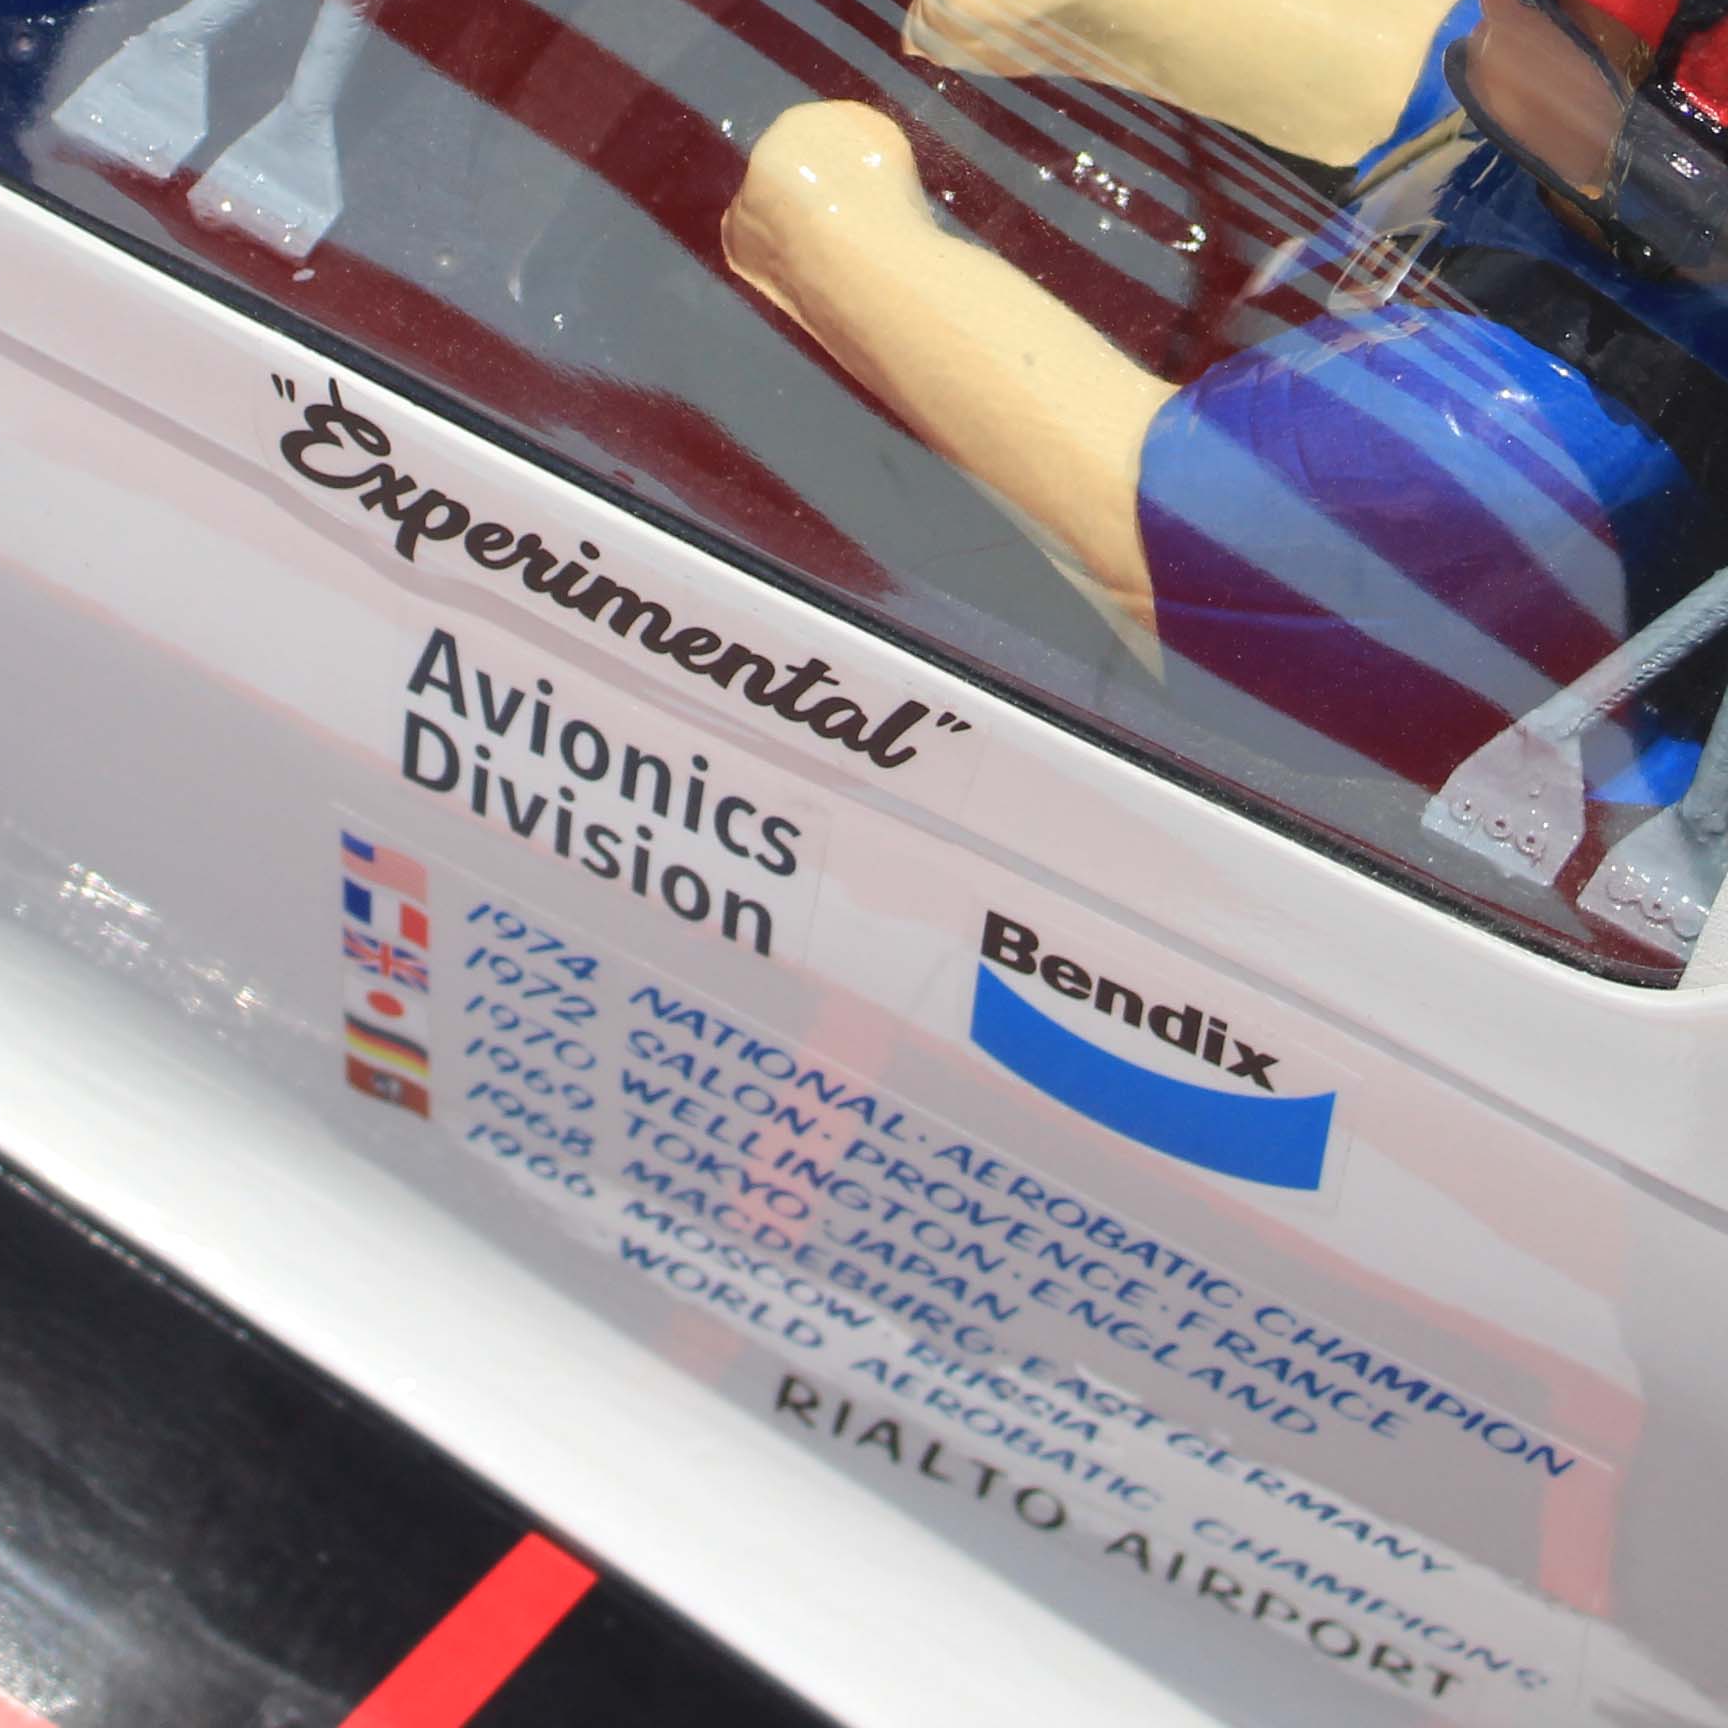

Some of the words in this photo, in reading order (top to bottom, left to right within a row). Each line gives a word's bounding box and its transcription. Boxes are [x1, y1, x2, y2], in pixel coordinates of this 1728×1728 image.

[401, 709, 774, 958] Division
[407, 628, 801, 877] Avionics
[466, 1082, 596, 1158] 1968
[979, 909, 1279, 1093] Bendix
[464, 946, 598, 1026] 1972
[1176, 1310, 1409, 1439] FRANCE
[464, 995, 597, 1071] 1970
[1029, 1278, 1318, 1436] ENGLAND
[467, 903, 599, 982] 1974
[933, 1141, 1244, 1310] AEROBATIC
[1254, 1305, 1575, 1478] CHAMPION
[823, 1228, 1021, 1322] JAPAN
[621, 1235, 824, 1349] WORLD
[848, 1356, 1165, 1511] AEROBATIC
[775, 1372, 1068, 1532] RIALTO
[1104, 1532, 1465, 1699] AIRPORT
